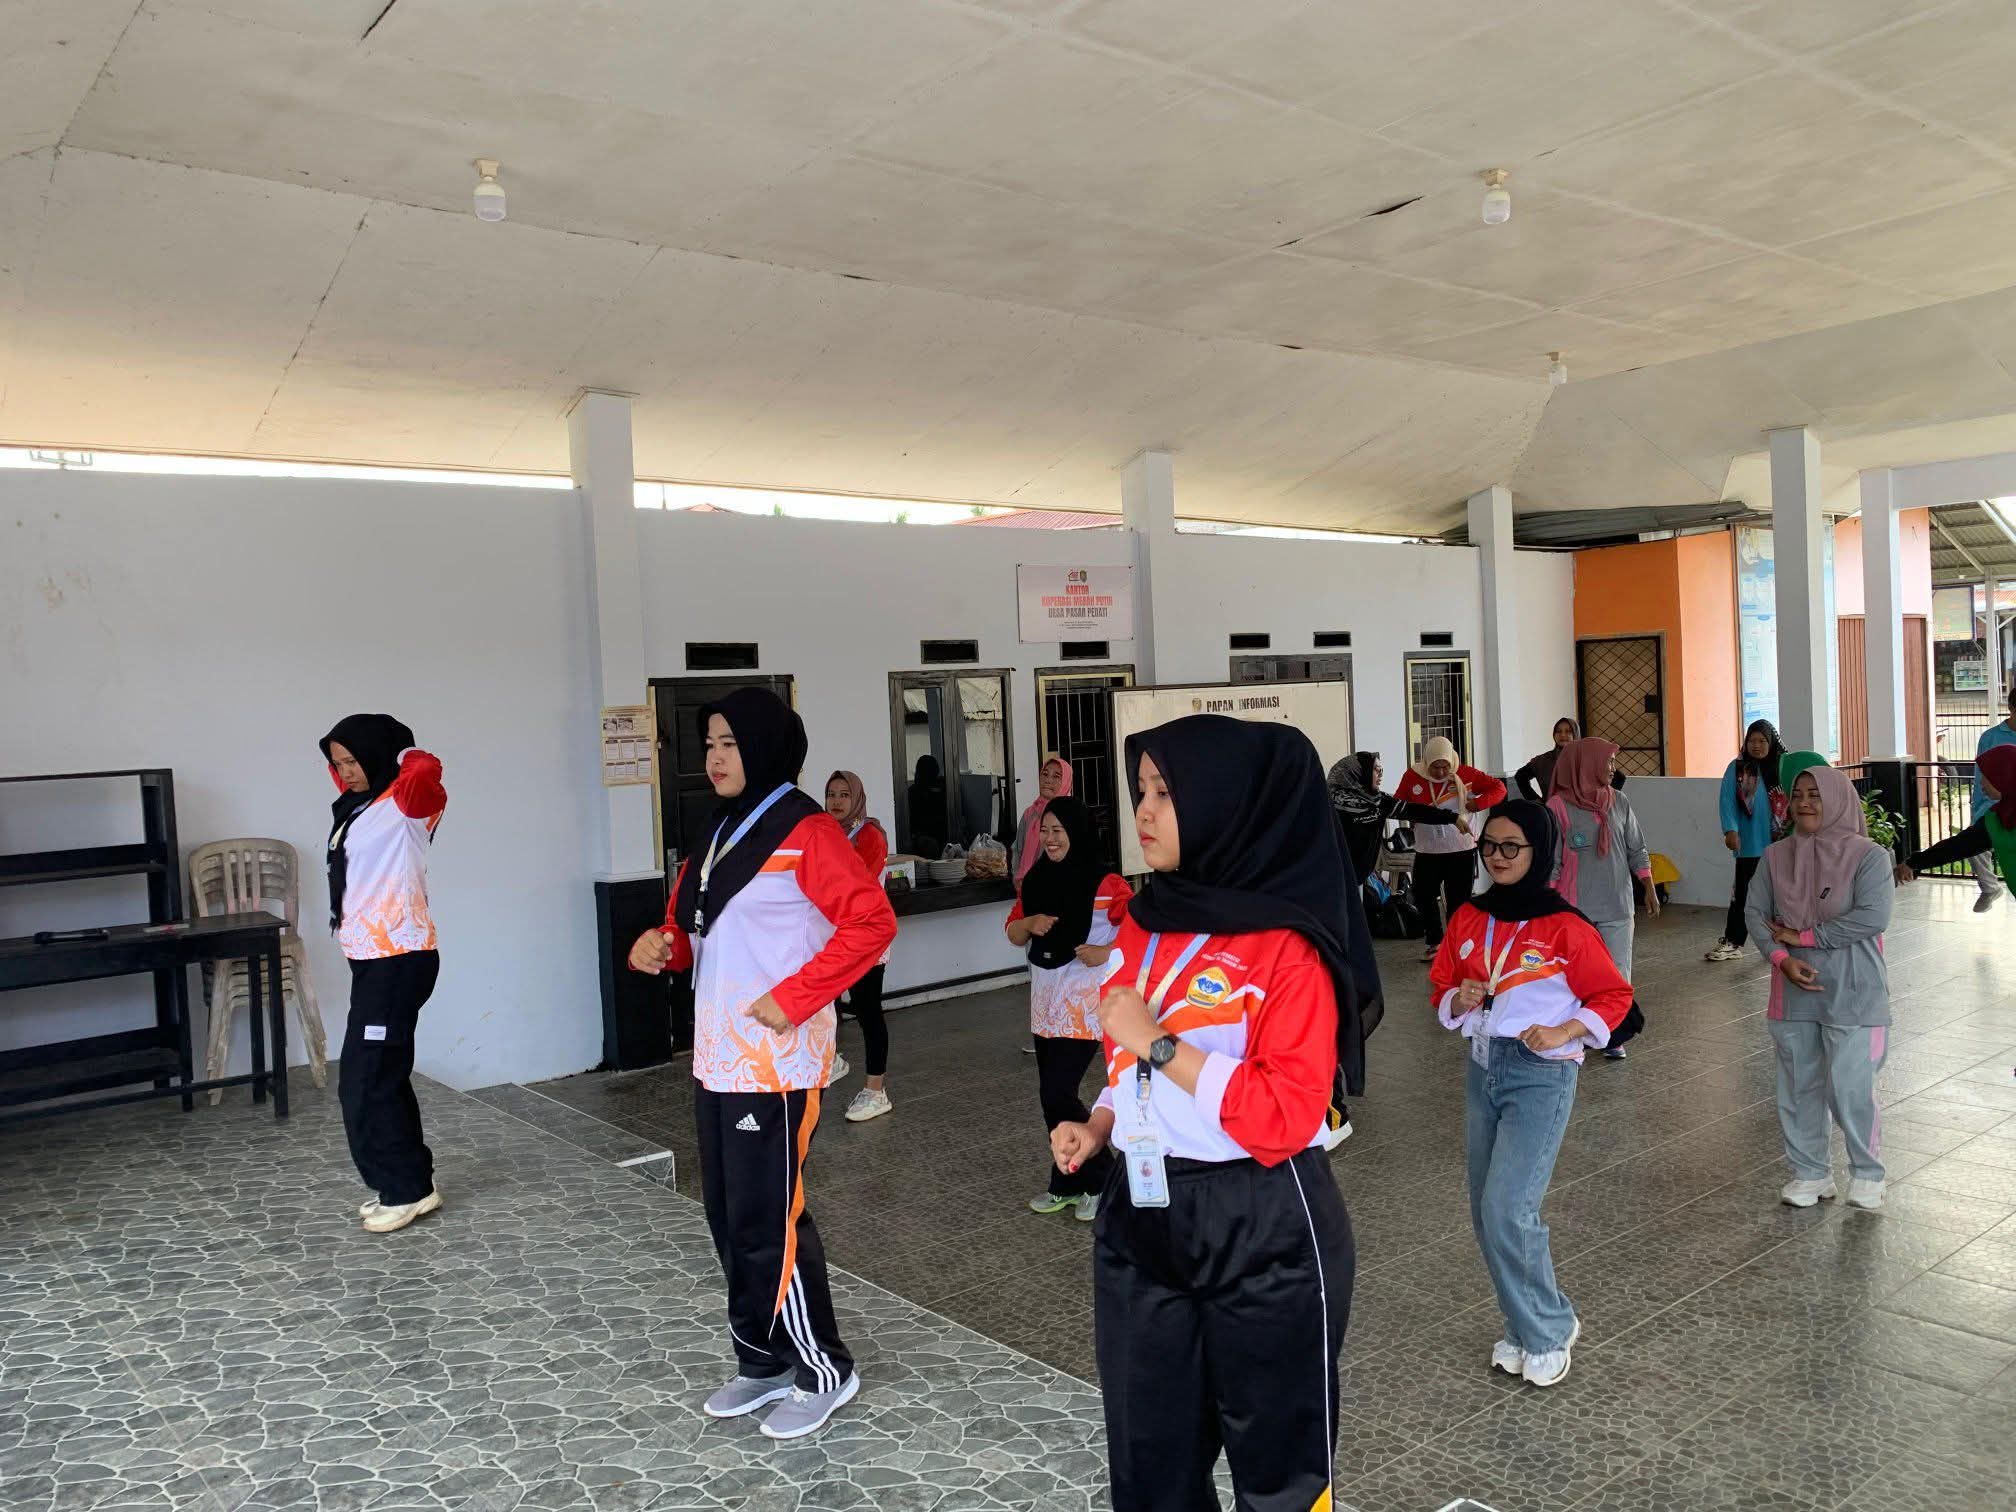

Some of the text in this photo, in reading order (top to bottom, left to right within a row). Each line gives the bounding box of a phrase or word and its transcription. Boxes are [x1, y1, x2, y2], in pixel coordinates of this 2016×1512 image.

[1048, 607, 1065, 618] DESA
[1066, 607, 1086, 618] PASAR
[1206, 696, 1280, 713] PAPAN INFORMASI
